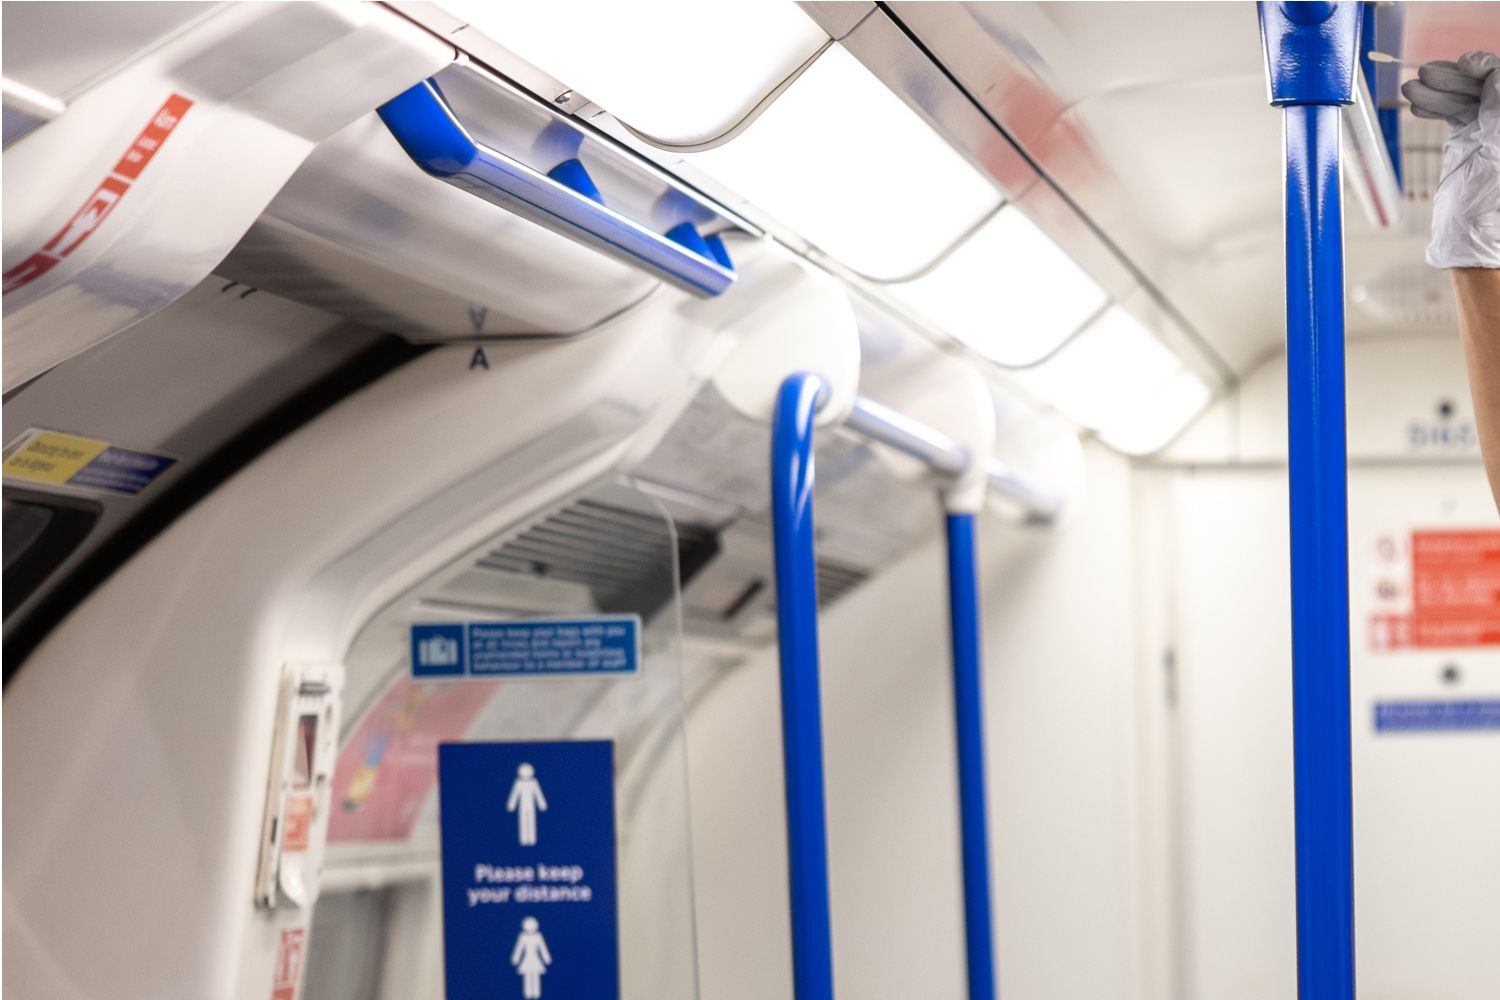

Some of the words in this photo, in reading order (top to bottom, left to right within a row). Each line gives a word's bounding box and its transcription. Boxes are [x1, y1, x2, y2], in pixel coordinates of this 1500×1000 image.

[469, 347, 490, 370] A
[475, 864, 534, 882] Please
[537, 863, 583, 882] keep
[467, 887, 511, 906] your
[514, 885, 592, 902] distance
